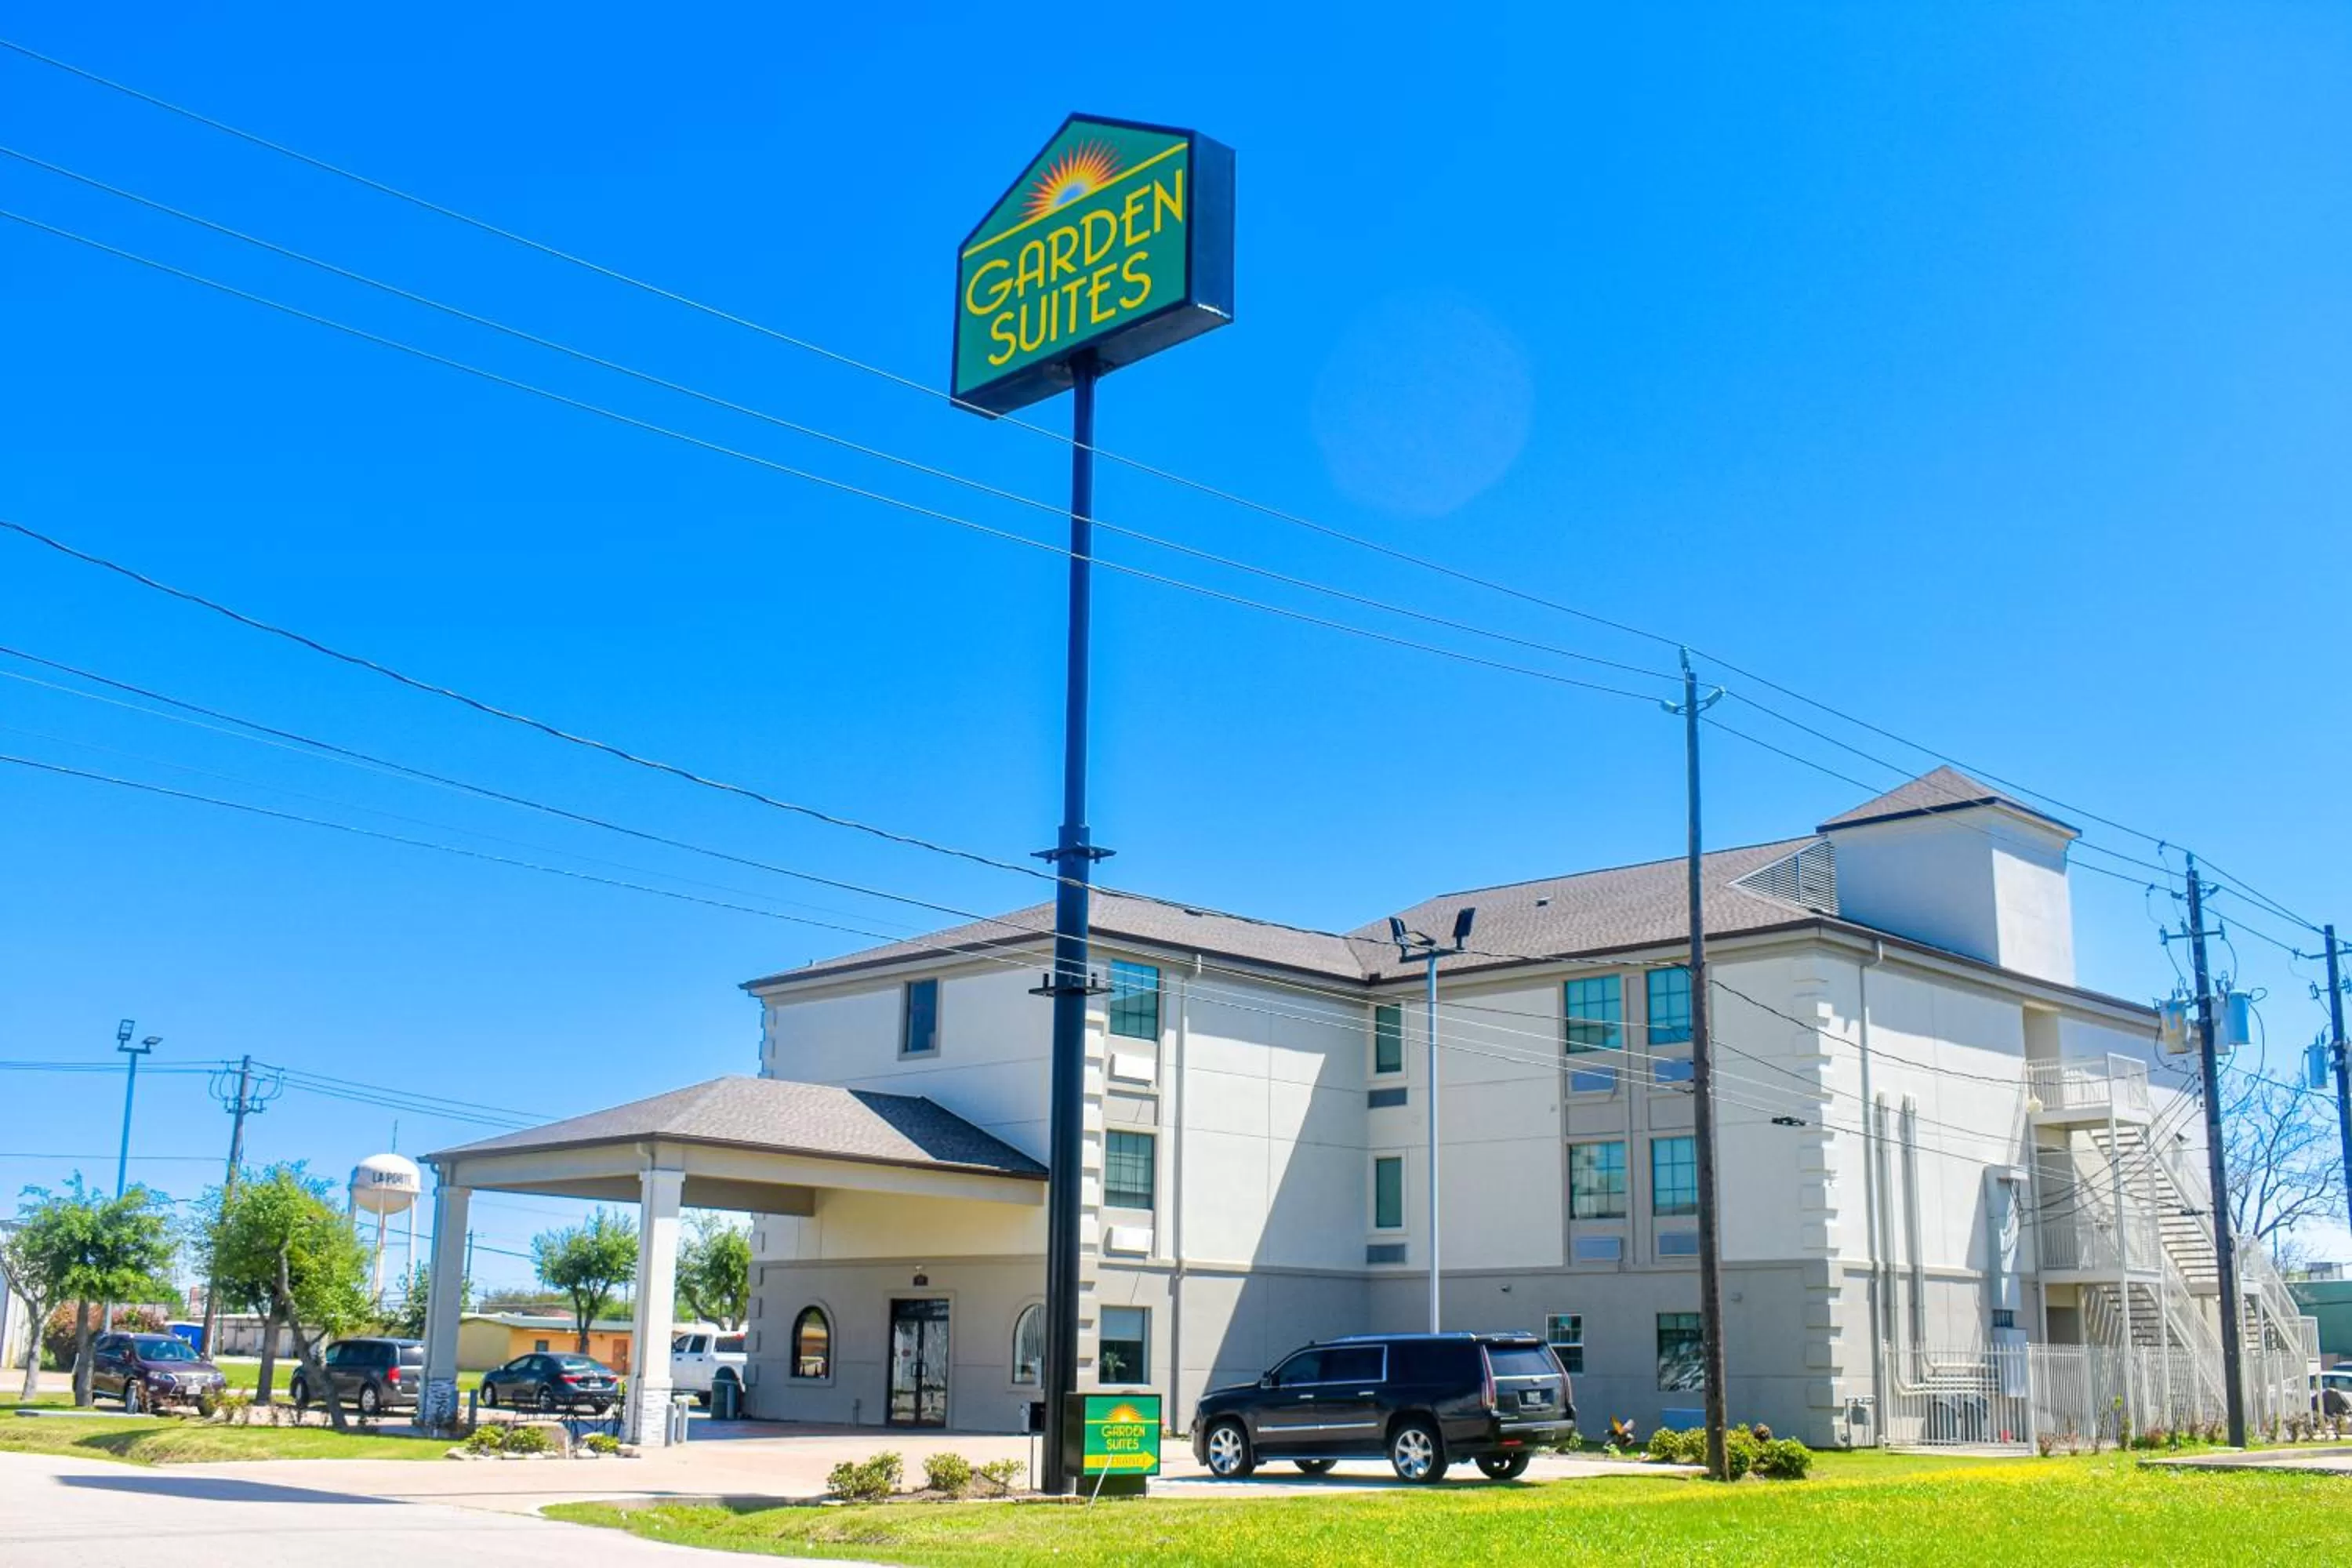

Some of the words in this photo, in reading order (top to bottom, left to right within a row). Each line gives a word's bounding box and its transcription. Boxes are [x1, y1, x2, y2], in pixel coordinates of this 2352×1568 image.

[965, 169, 1184, 316] GARDEN
[988, 251, 1152, 365] SUITES
[372, 1172, 384, 1183] LA
[1102, 1425, 1145, 1437] GARDEN
[1106, 1439, 1139, 1450] SUITES
